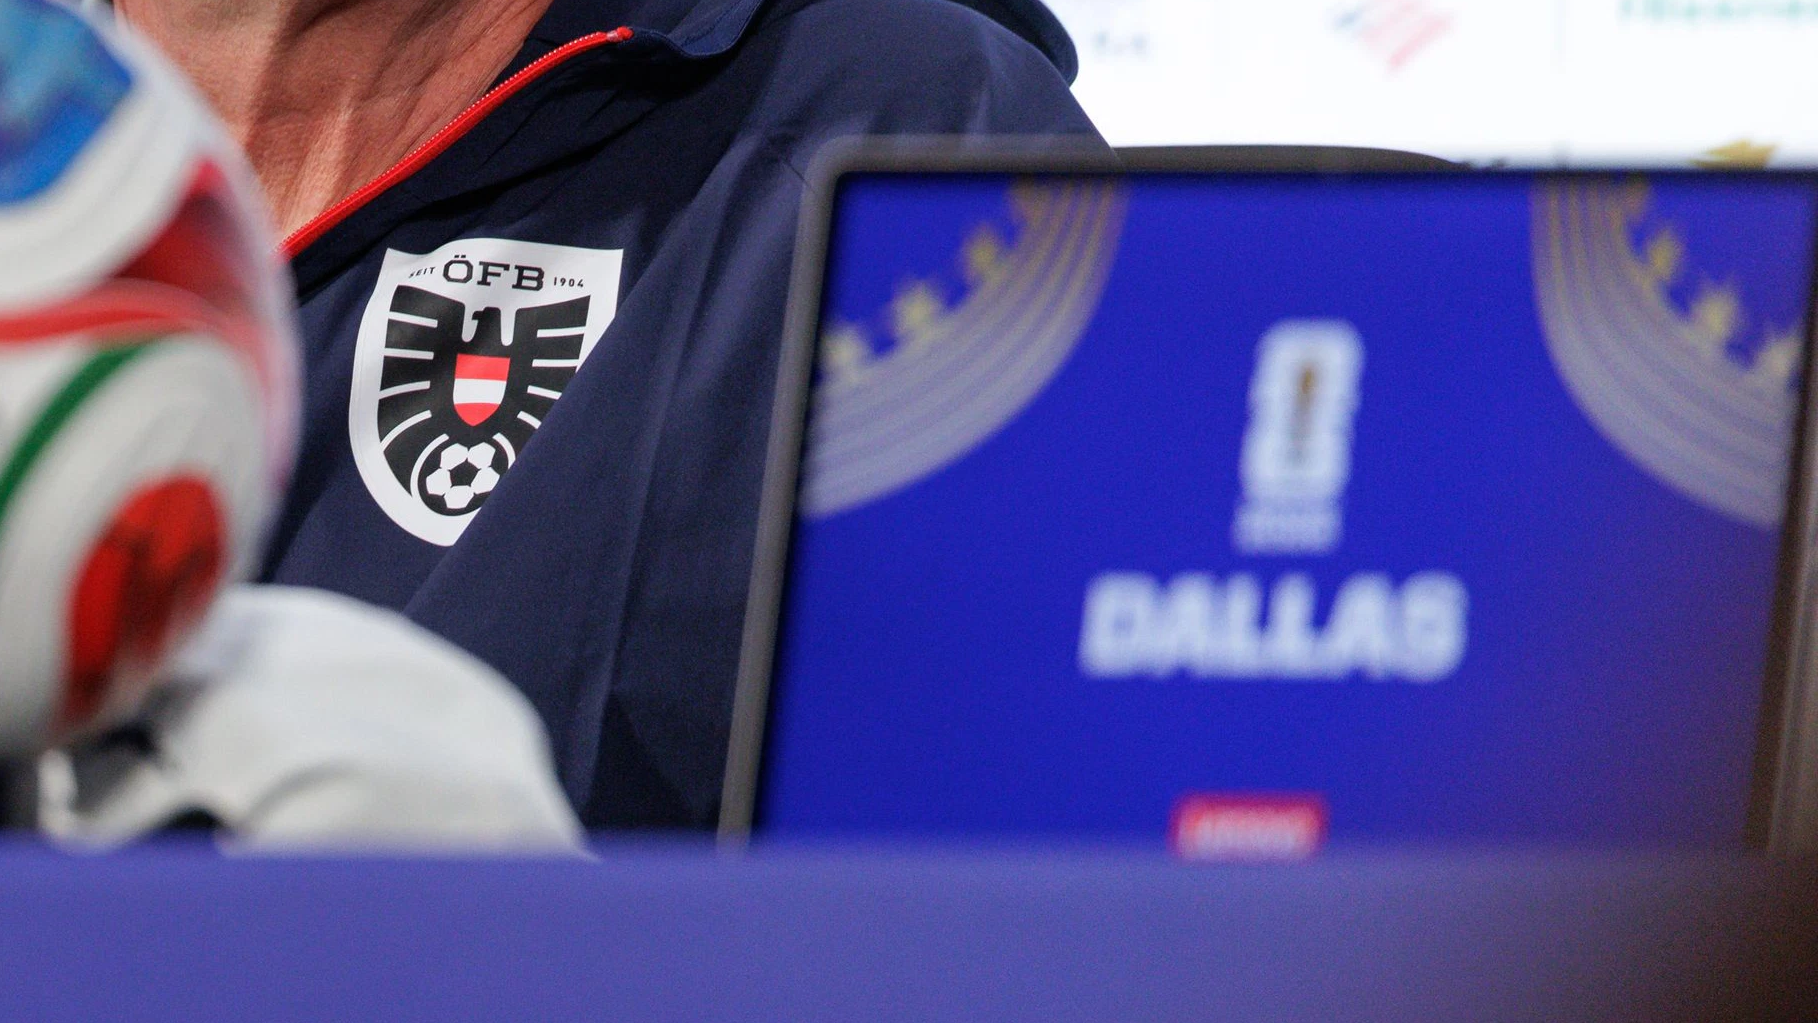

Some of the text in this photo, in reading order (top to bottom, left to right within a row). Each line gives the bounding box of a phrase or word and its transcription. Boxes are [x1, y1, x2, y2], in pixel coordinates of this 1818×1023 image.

[408, 254, 585, 292] SEIT ÖFB 1904
[1080, 572, 1470, 681] DALLAS
